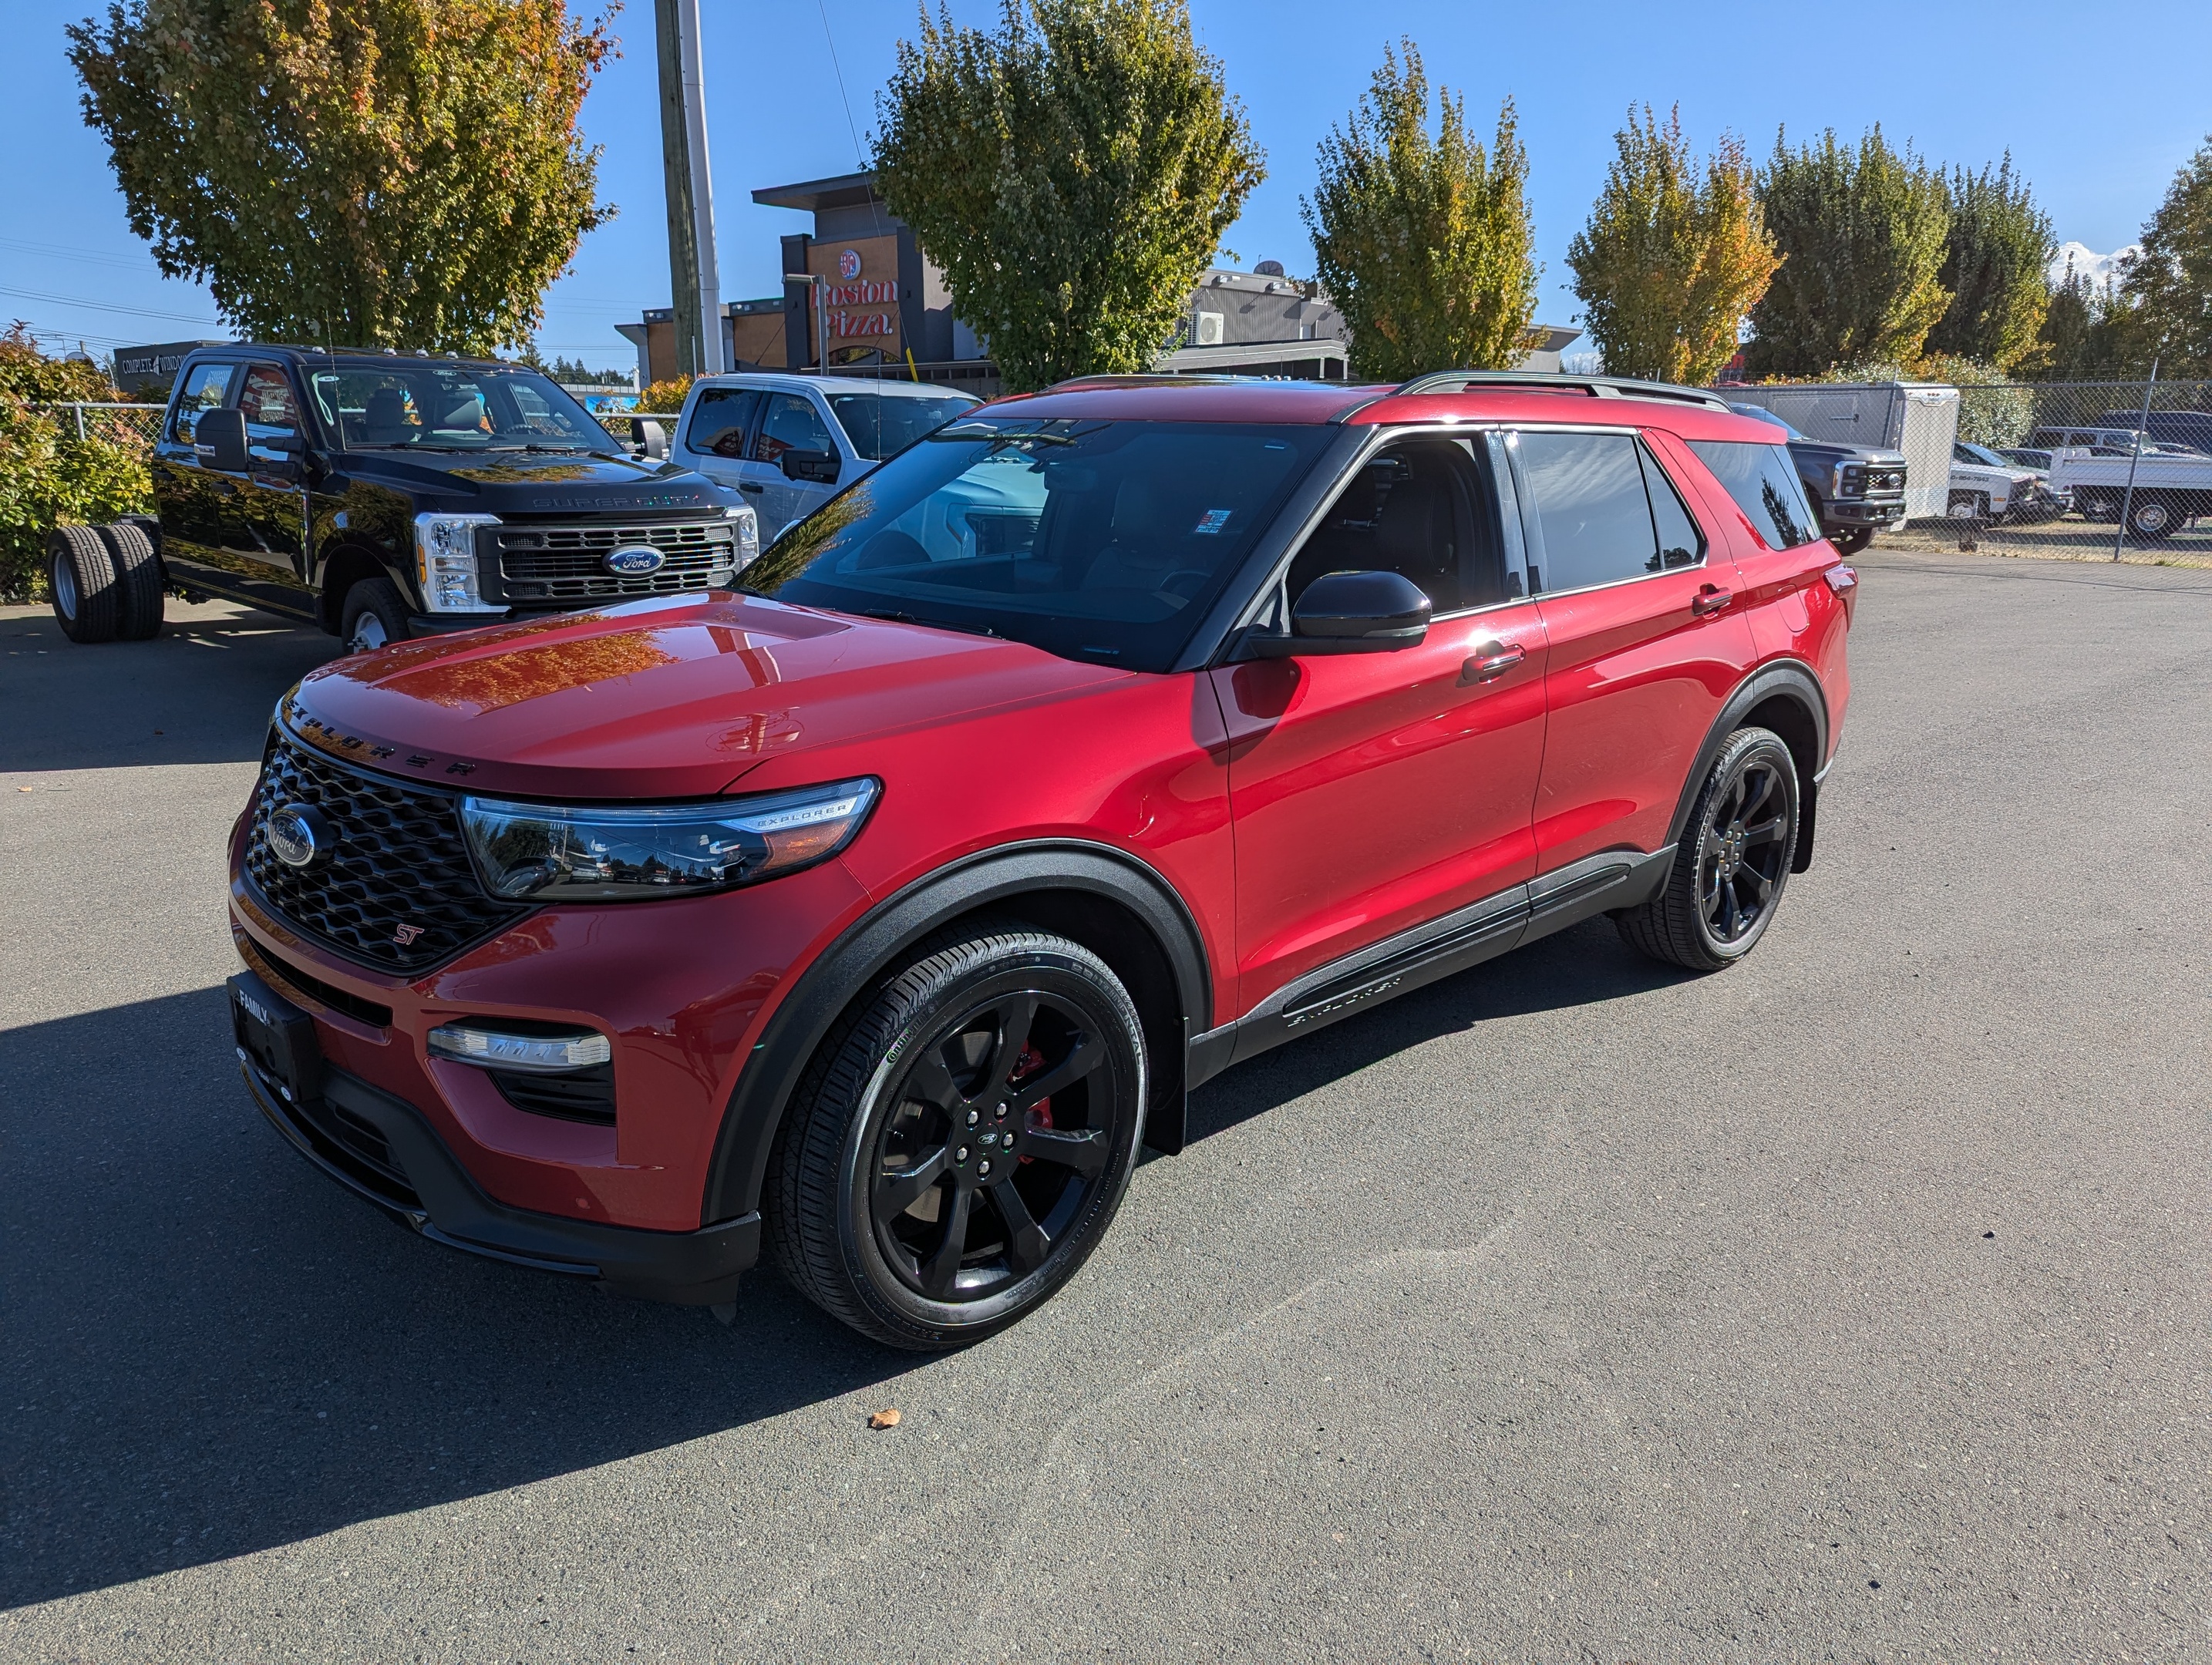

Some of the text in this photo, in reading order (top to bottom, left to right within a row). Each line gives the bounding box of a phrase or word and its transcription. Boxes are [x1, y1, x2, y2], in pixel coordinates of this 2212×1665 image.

[123, 358, 153, 374] COMPLETE
[534, 497, 633, 508] SUPER
[622, 553, 651, 569] Ford
[285, 698, 477, 776] EXPLORER
[757, 804, 847, 827] EXPLORER
[271, 819, 300, 855] Ford
[393, 923, 425, 946] ST
[239, 988, 268, 1026] FAMILY
[1070, 960, 1143, 1066] CONTINENTAL
